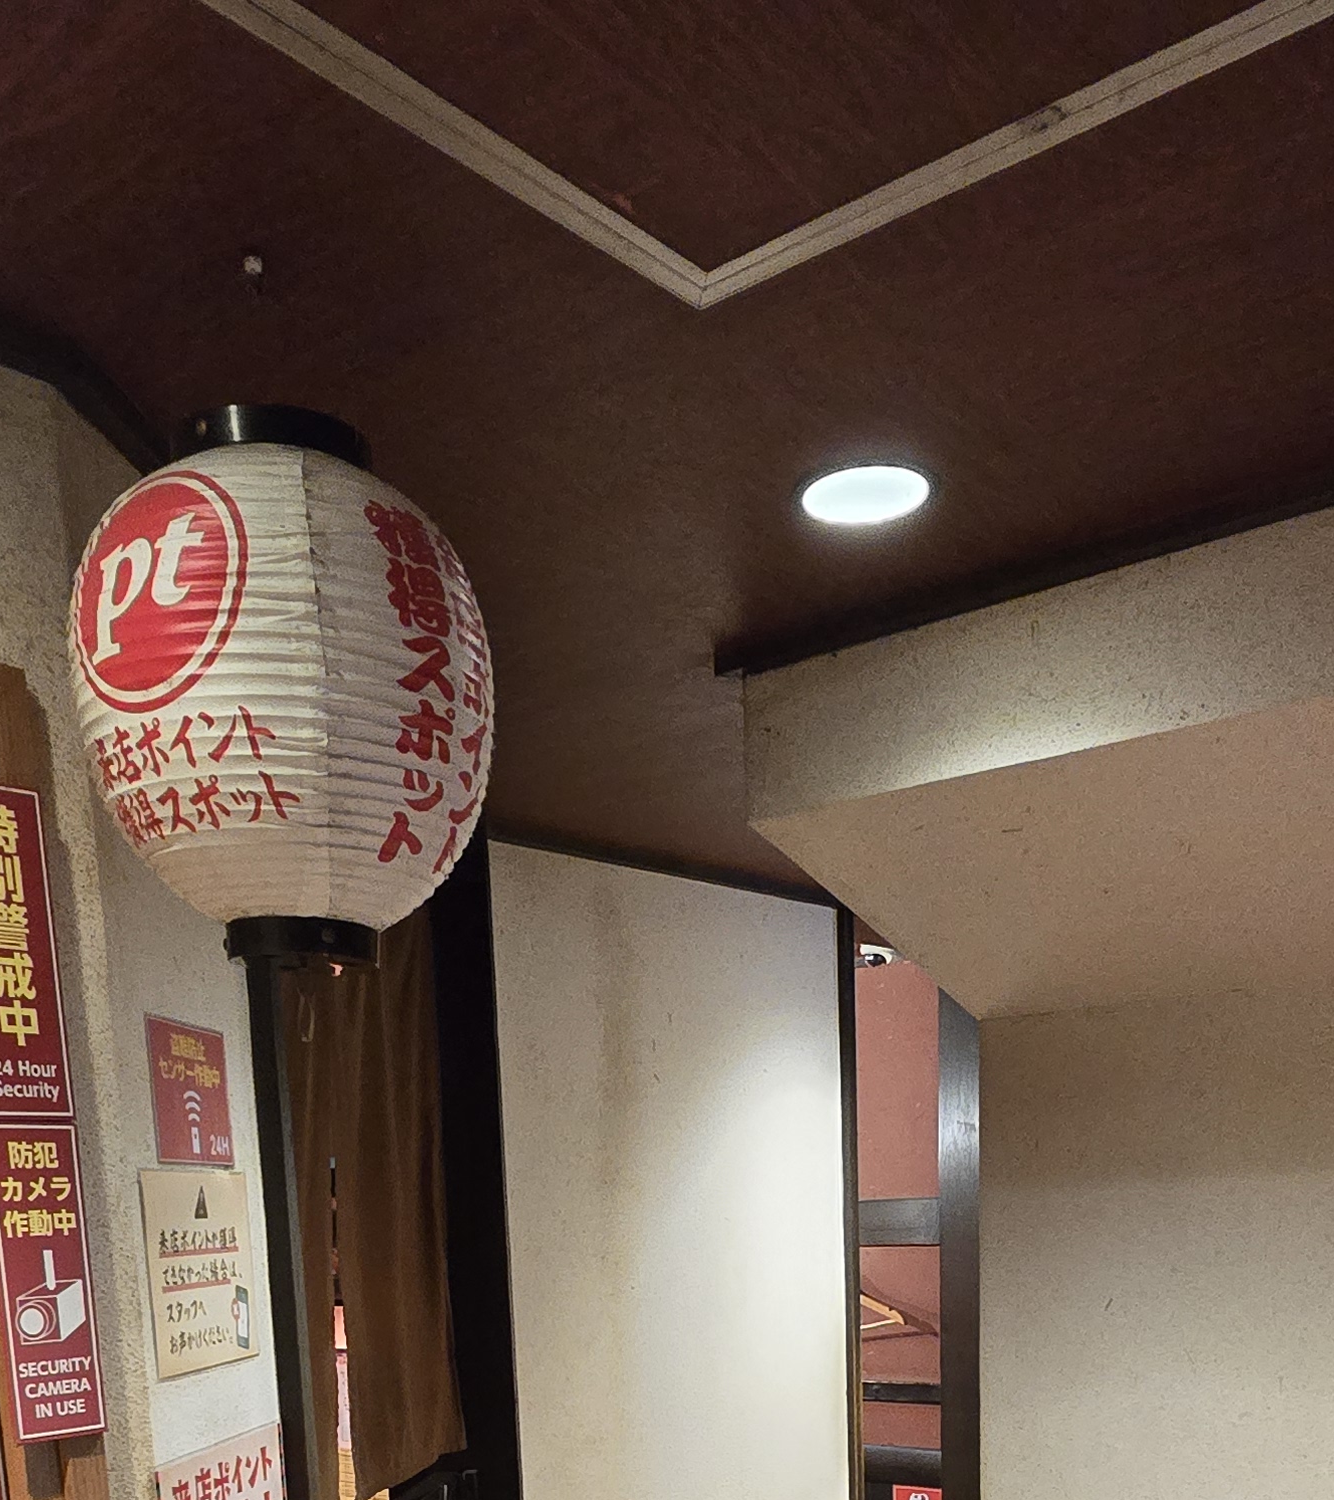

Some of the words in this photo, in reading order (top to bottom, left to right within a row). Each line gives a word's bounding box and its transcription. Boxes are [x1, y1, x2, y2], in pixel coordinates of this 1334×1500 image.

[92, 513, 206, 666] pt
[95, 705, 277, 793] 来店ポイント
[116, 771, 301, 849] 獲得スポット
[19, 1060, 57, 1078] Hour
[7, 1141, 59, 1169] 防犯
[209, 1134, 230, 1157] 24H
[0, 1177, 72, 1202] カメラ
[3, 1209, 77, 1238] 作動中
[166, 1300, 207, 1323] スタッフへ
[19, 1356, 92, 1378] SECURITY
[24, 1378, 92, 1399] CAMERA
[35, 1402, 53, 1418] IN
[56, 1399, 86, 1415] USE
